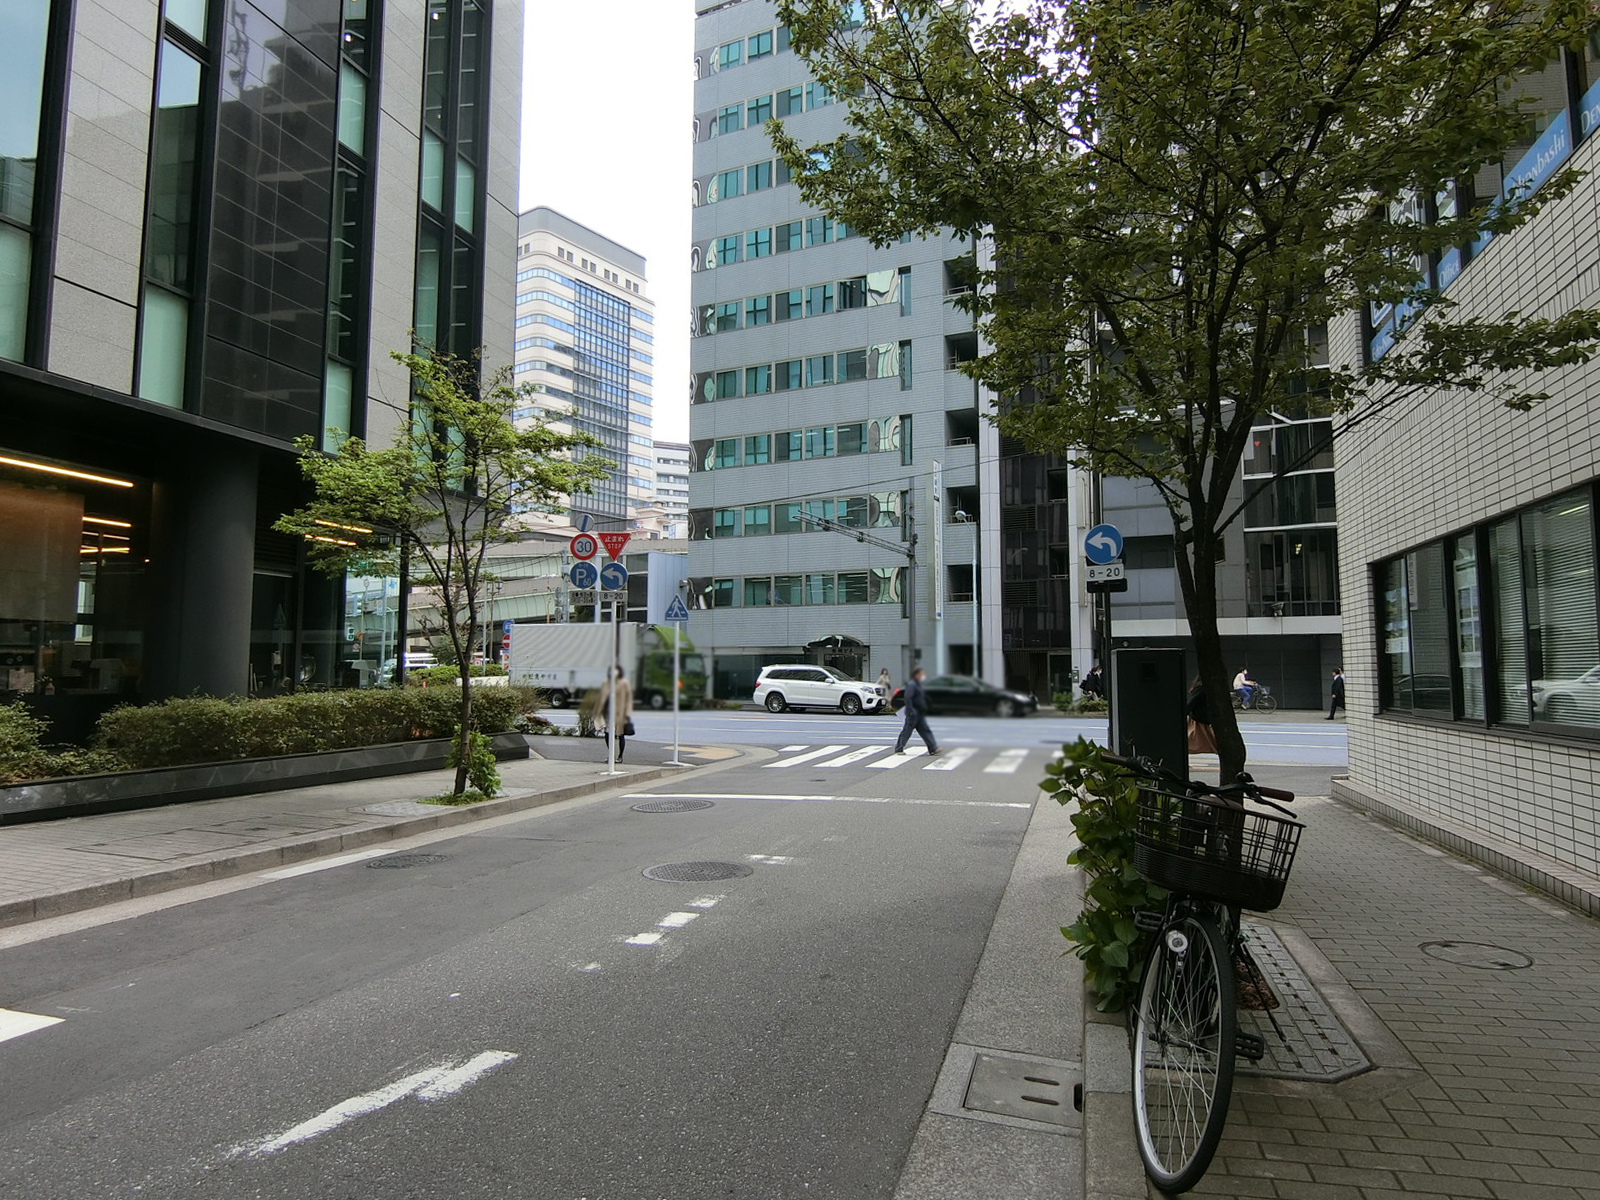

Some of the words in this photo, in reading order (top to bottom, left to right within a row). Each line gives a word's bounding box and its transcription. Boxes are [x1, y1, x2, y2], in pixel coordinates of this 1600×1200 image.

[576, 541, 592, 553] 30
[1089, 567, 1120, 578] 8-20
[603, 592, 624, 600] 8-20
